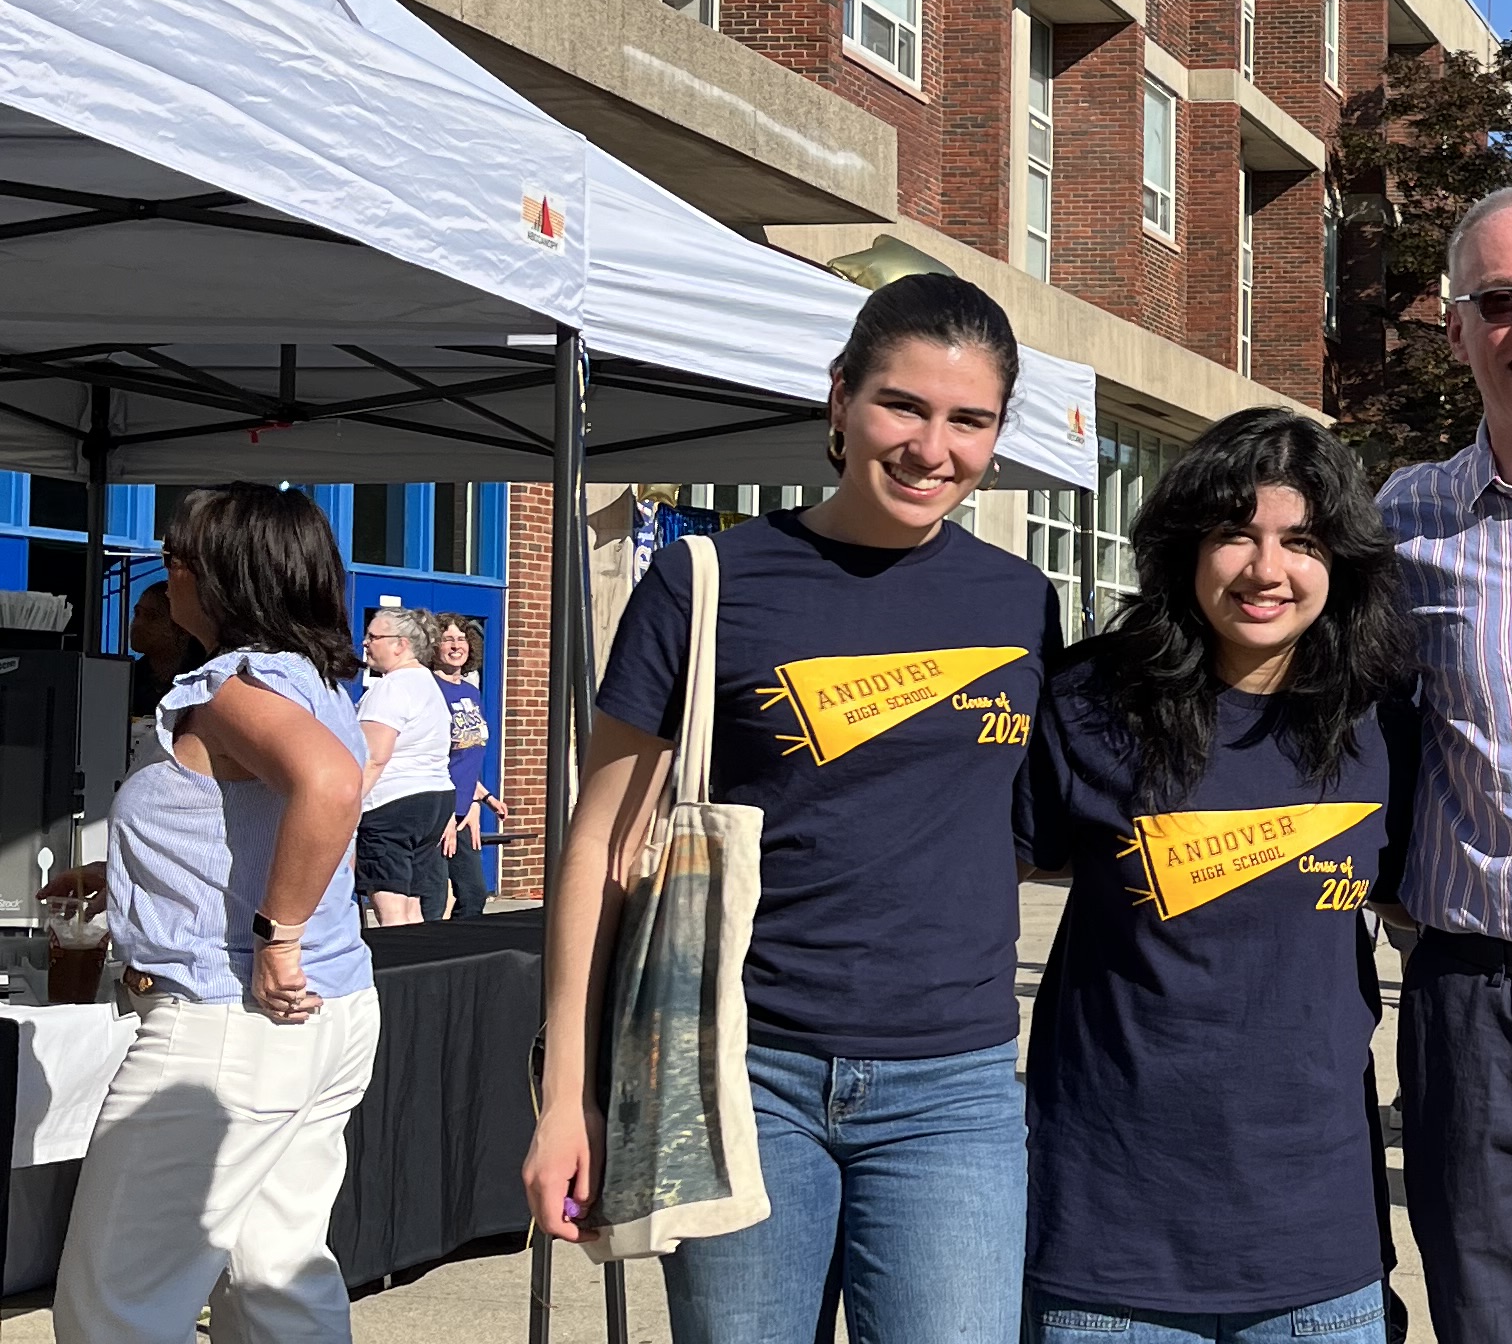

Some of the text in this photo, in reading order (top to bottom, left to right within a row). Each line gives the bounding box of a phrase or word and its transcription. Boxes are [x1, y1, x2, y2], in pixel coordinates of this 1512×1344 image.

[818, 659, 943, 710] ANDOVER
[952, 692, 1011, 712] Class of
[844, 686, 938, 725] HIGH SCHOOL
[977, 712, 1030, 746] 2024
[1167, 815, 1296, 867] ANDOVER
[1190, 846, 1285, 884] HIGH SCHOOL
[1299, 855, 1354, 879] Class of
[1315, 878, 1370, 910] 2024
